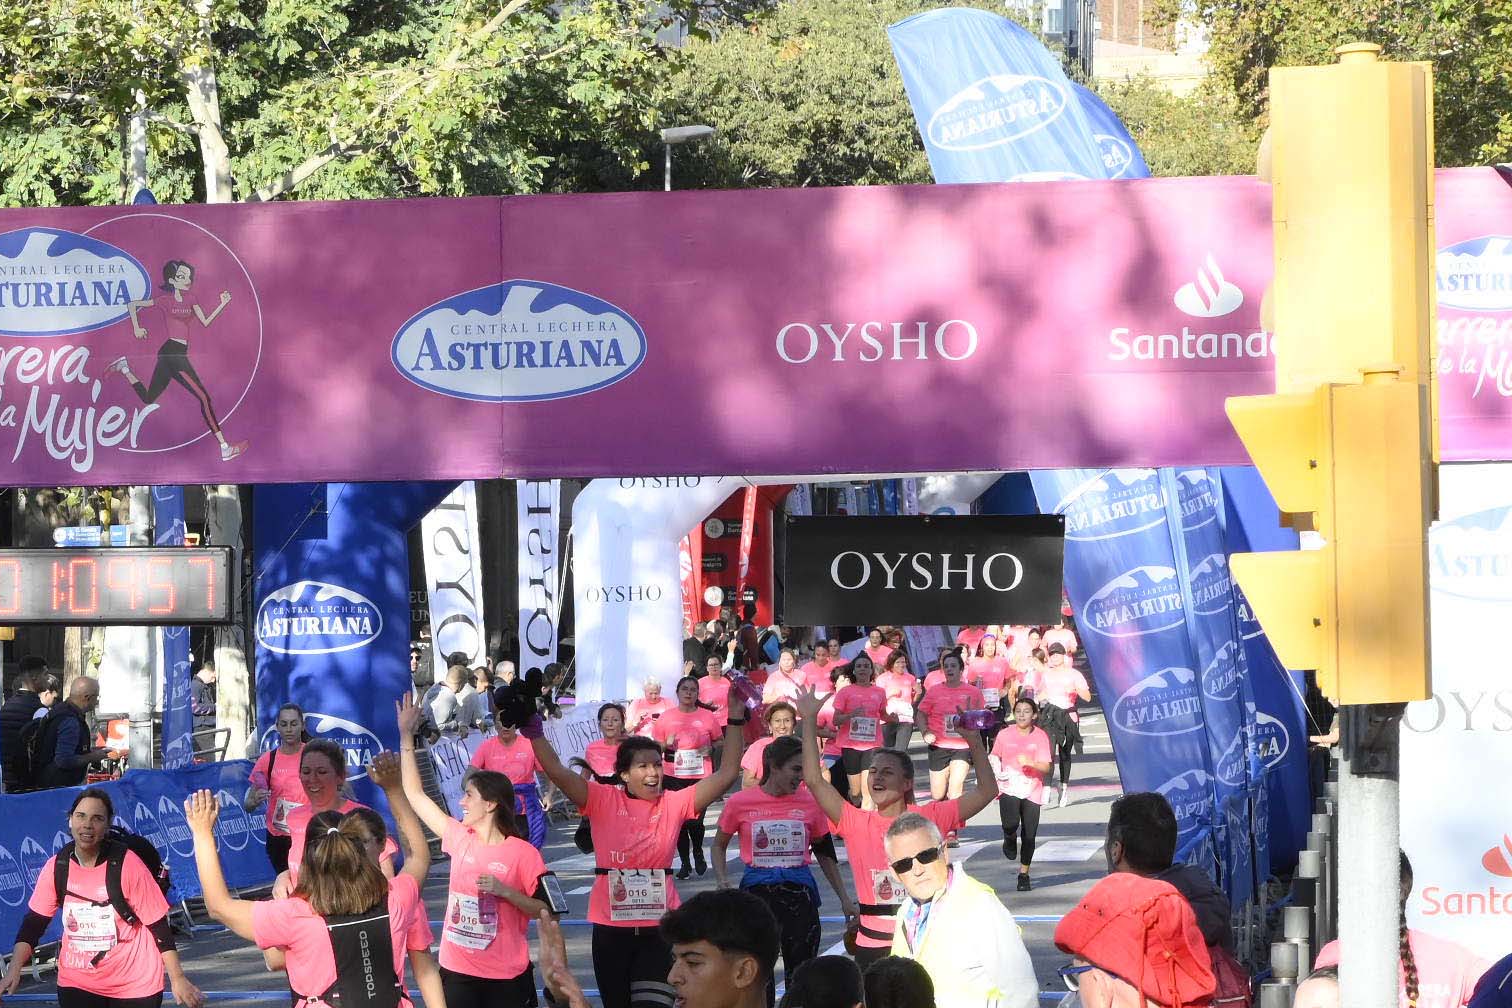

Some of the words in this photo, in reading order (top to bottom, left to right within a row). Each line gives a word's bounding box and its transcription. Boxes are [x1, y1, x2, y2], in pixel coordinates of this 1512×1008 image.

[53, 263, 126, 275] LECHERA
[451, 324, 529, 335] CENTRAL
[538, 321, 618, 333] LECHERA
[411, 328, 627, 371] ASTURIANA
[775, 319, 979, 363] OYSHO
[12, 379, 160, 473] Mujer
[830, 550, 1024, 591] OYSHO
[586, 583, 662, 603] OYSHO
[260, 610, 374, 638] ASTURIANA
[769, 838, 788, 846] 016
[609, 850, 625, 864] TU
[628, 889, 648, 897] 016
[460, 914, 478, 925] 016
